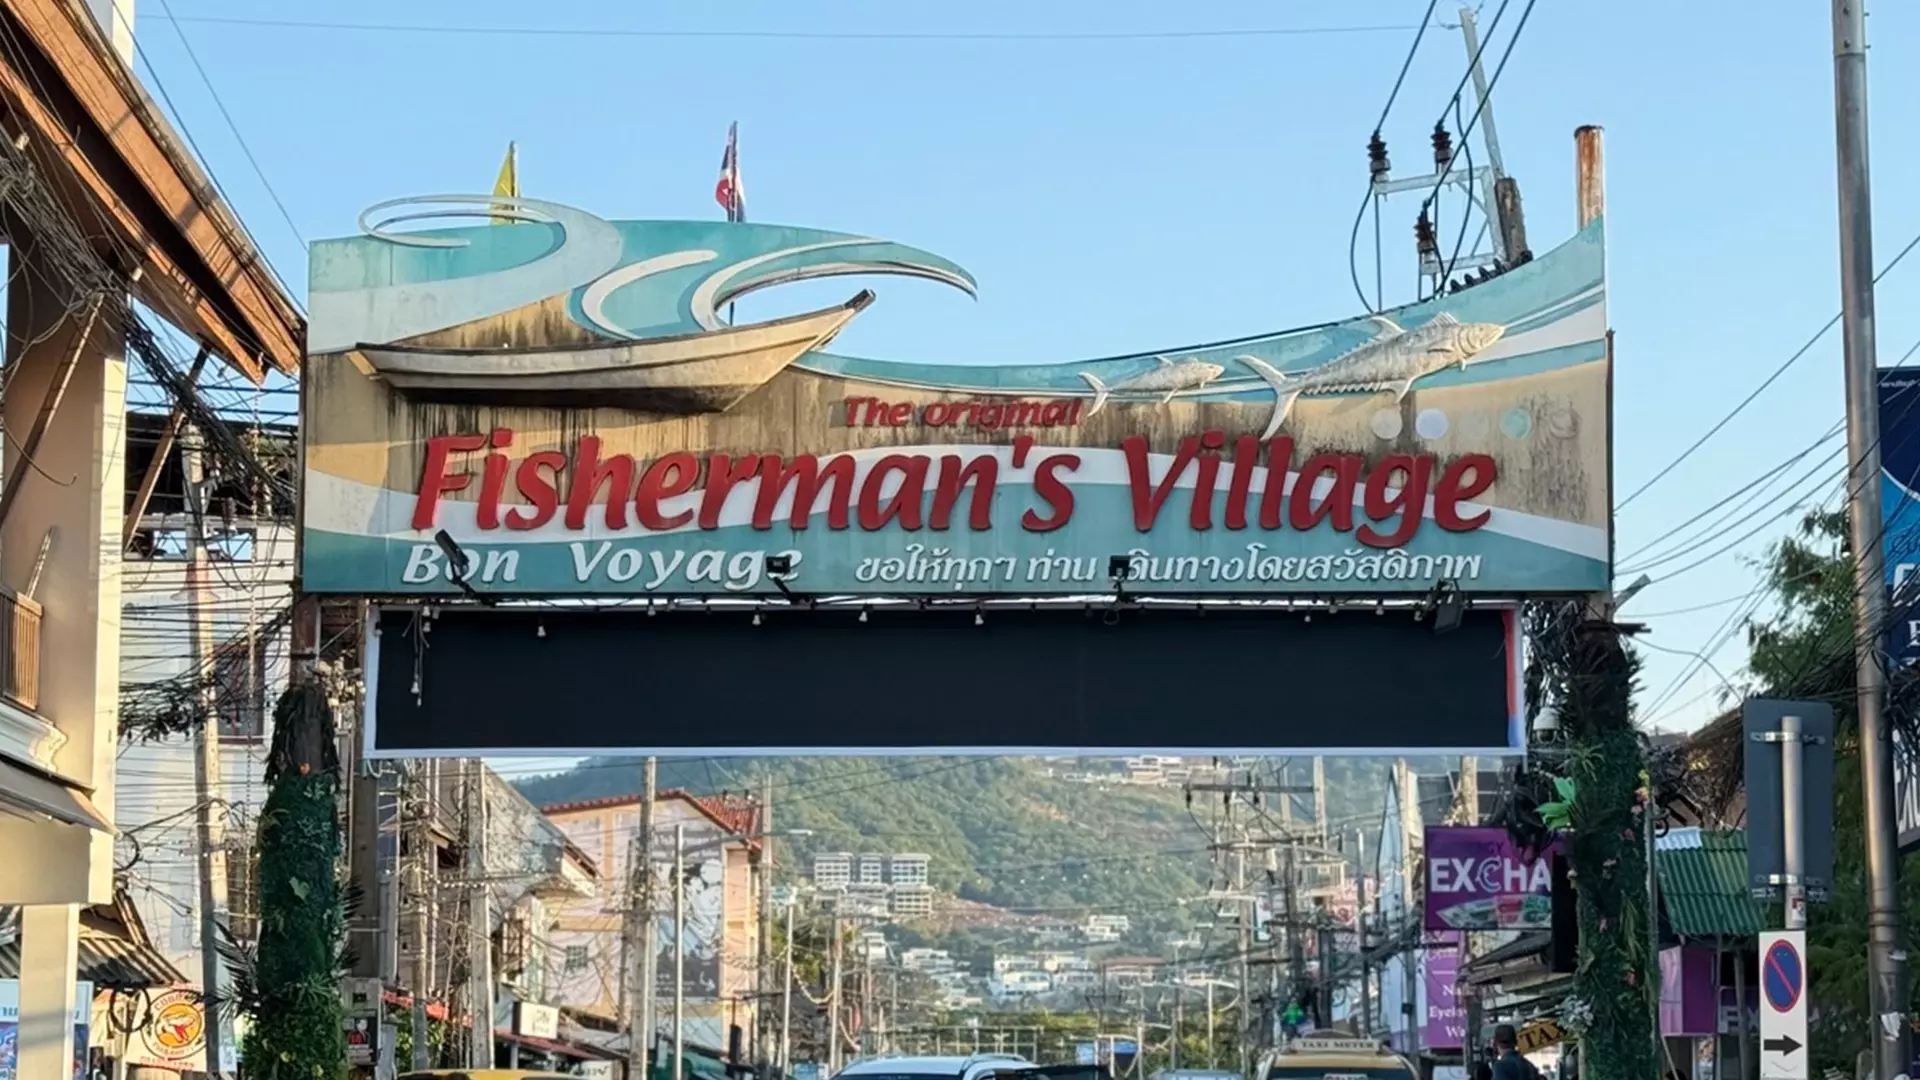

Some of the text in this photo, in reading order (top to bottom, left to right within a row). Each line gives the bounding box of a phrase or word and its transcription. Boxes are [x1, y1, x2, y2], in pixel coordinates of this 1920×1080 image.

[844, 396, 1082, 428] The original
[411, 427, 1499, 548] Fisherman's Village
[402, 541, 804, 590] Bon Voyage
[1026, 548, 1097, 581] ท่าน
[1111, 544, 1482, 582] ดินทางโดยสวัสดิภาพ
